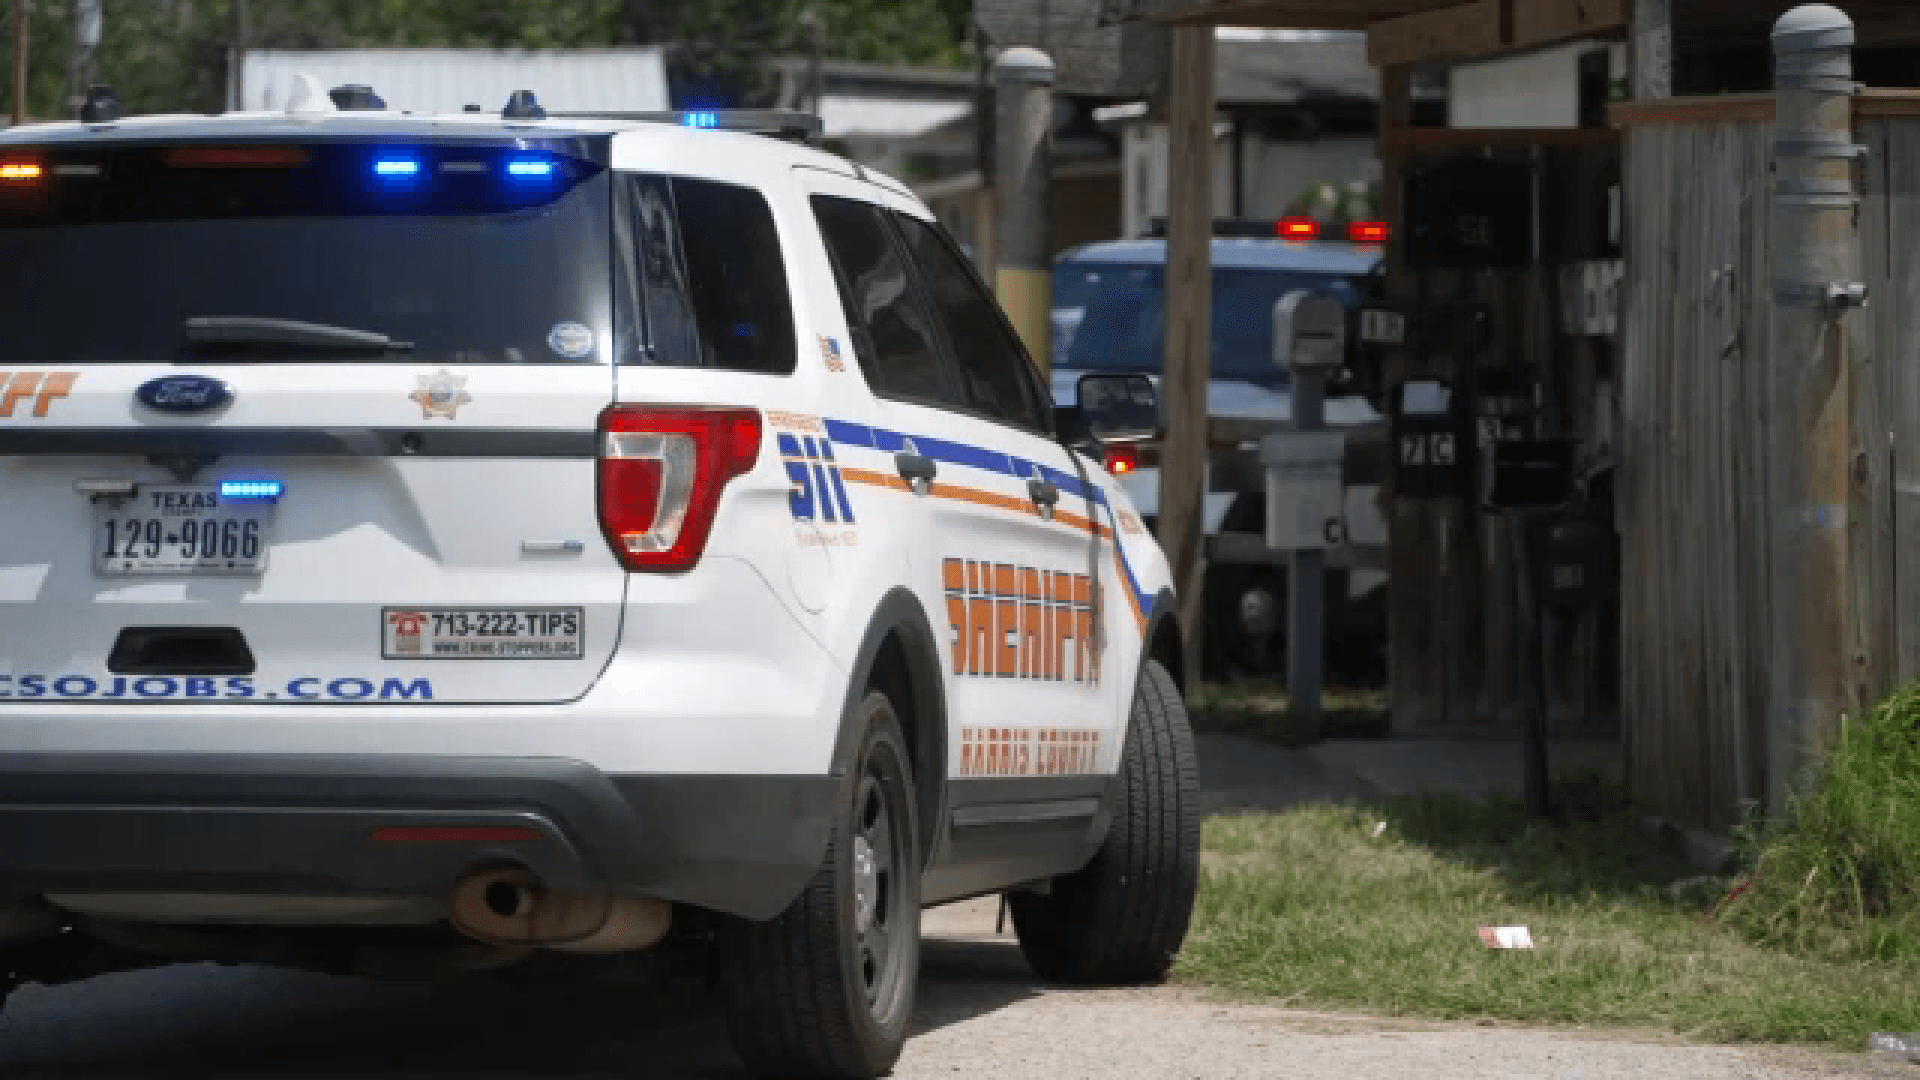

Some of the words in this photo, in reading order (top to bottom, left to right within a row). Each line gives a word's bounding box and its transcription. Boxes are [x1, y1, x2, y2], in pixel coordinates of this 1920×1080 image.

[0, 372, 81, 417] FF
[155, 380, 210, 405] Ford
[777, 432, 856, 524] 911
[152, 491, 217, 508] TEXAS
[431, 613, 578, 637] 713-222-TIPS
[959, 728, 1032, 775] HARRIS
[1037, 729, 1101, 775] COUNTY
